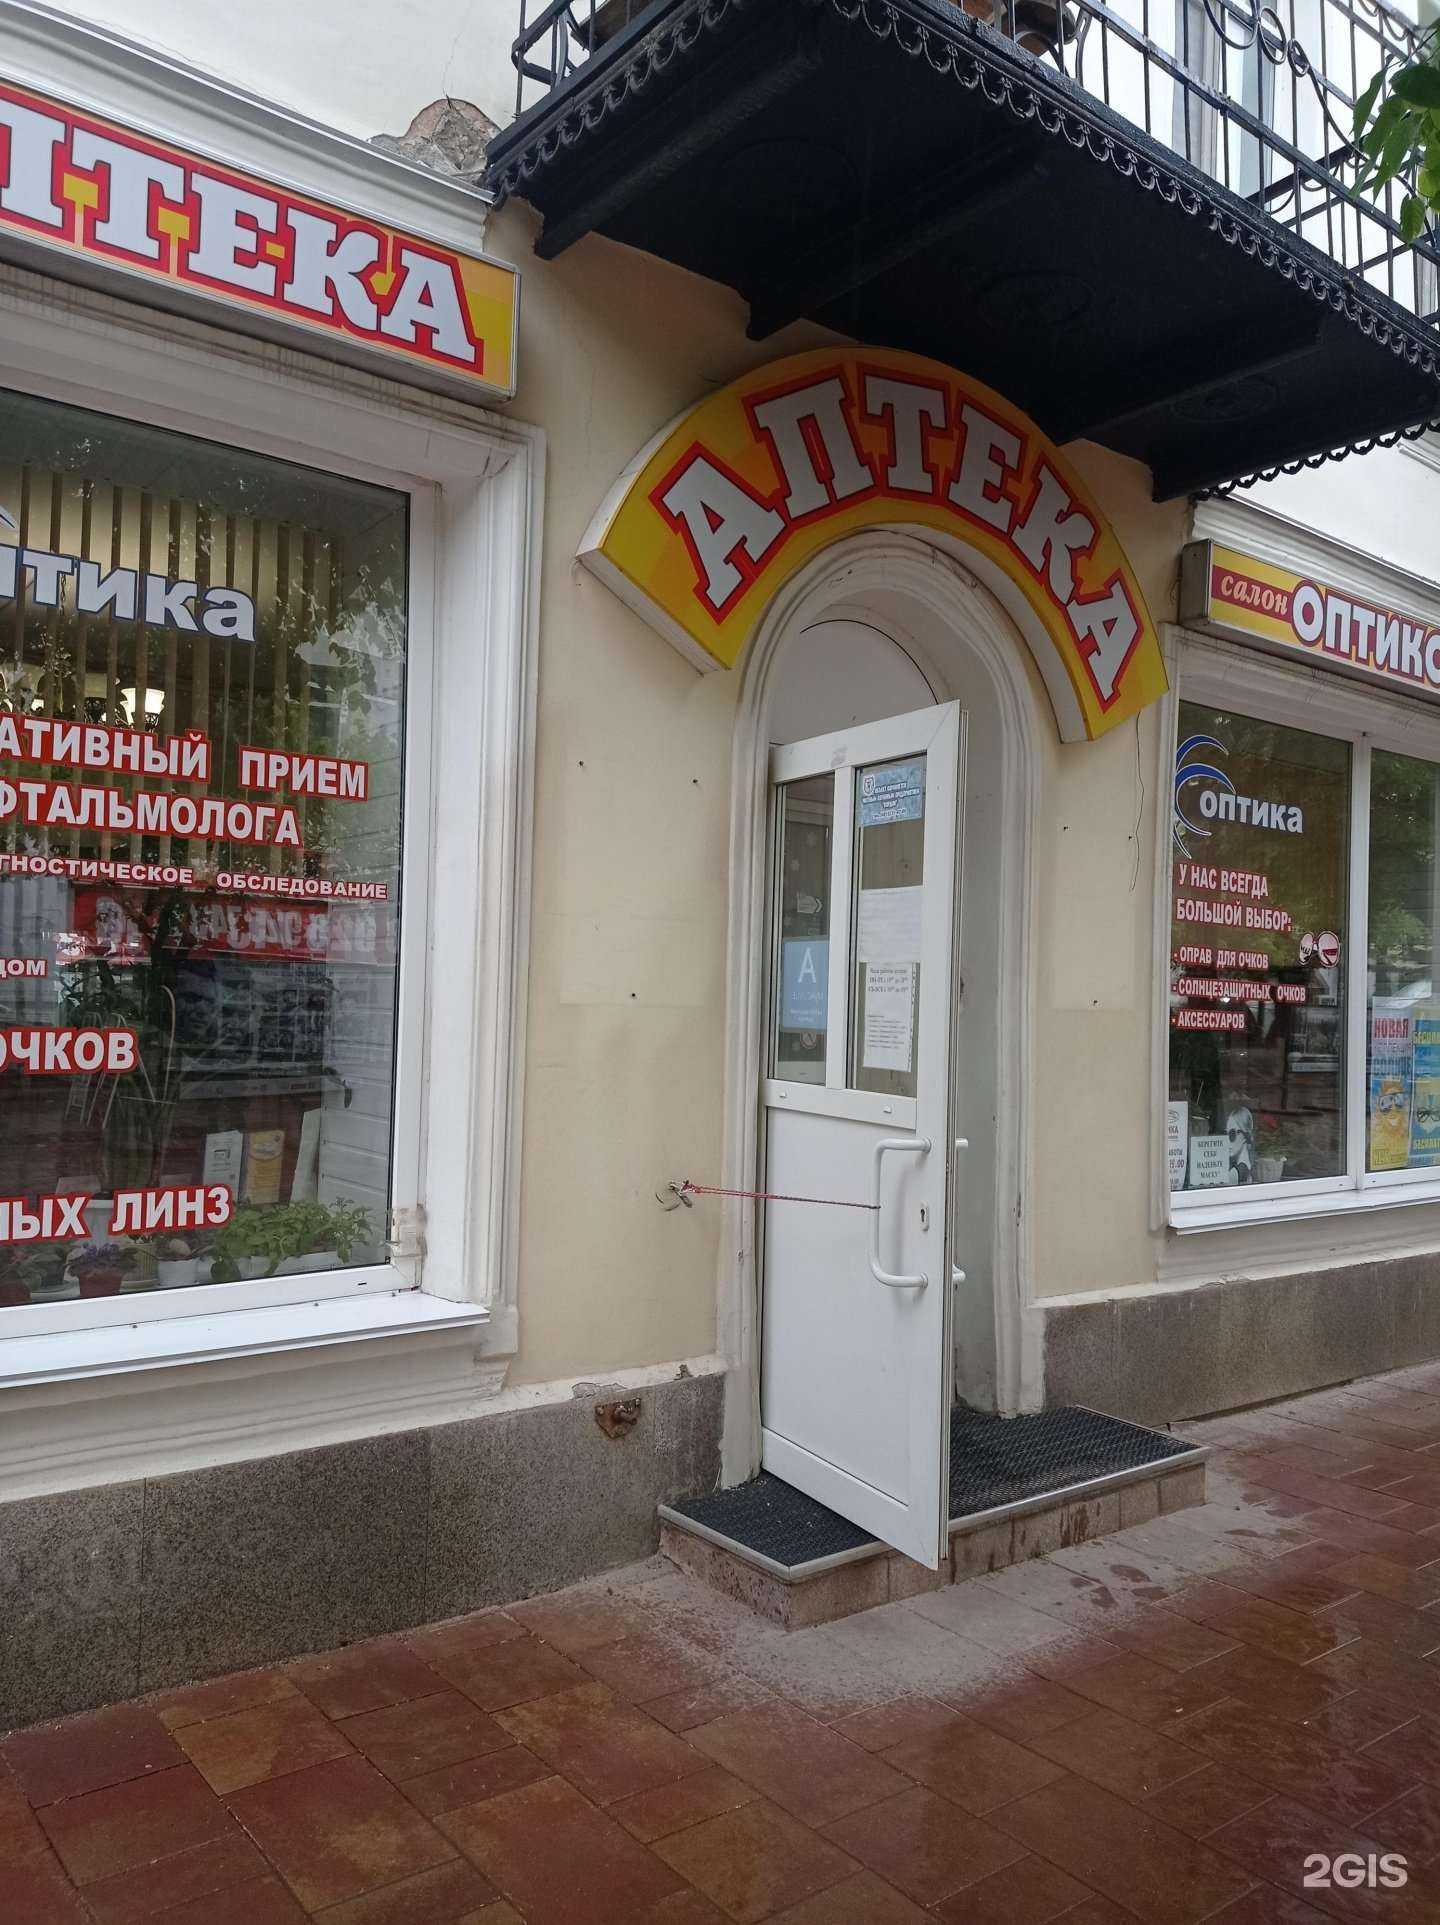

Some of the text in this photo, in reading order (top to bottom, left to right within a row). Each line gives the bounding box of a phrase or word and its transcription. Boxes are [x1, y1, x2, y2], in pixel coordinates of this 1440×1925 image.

[662, 375, 1140, 701] АПТЕКА
[0, 544, 256, 642] тика
[1221, 575, 1289, 616] салон
[0, 717, 366, 799] АТИВНЫЙ ПРИЕМ
[1200, 790, 1304, 834] оптика
[216, 872, 388, 899] ОБСЛЕДОВАНИЕ
[1179, 863, 1269, 900] У НАС ВСЕГДА
[1176, 898, 1292, 932] БОЛЬШОЙ ВЫБОР:
[1180, 946, 1269, 969] ОПРАВ ДЛЯ ОЧКОВ
[1178, 978, 1306, 1002] СОЛНЦЕЗАЩИТНЫХ ОЧКОВ
[1178, 1011, 1245, 1029] АКСЕССУАРОВ
[113, 1186, 230, 1232] ЛИНЗ
